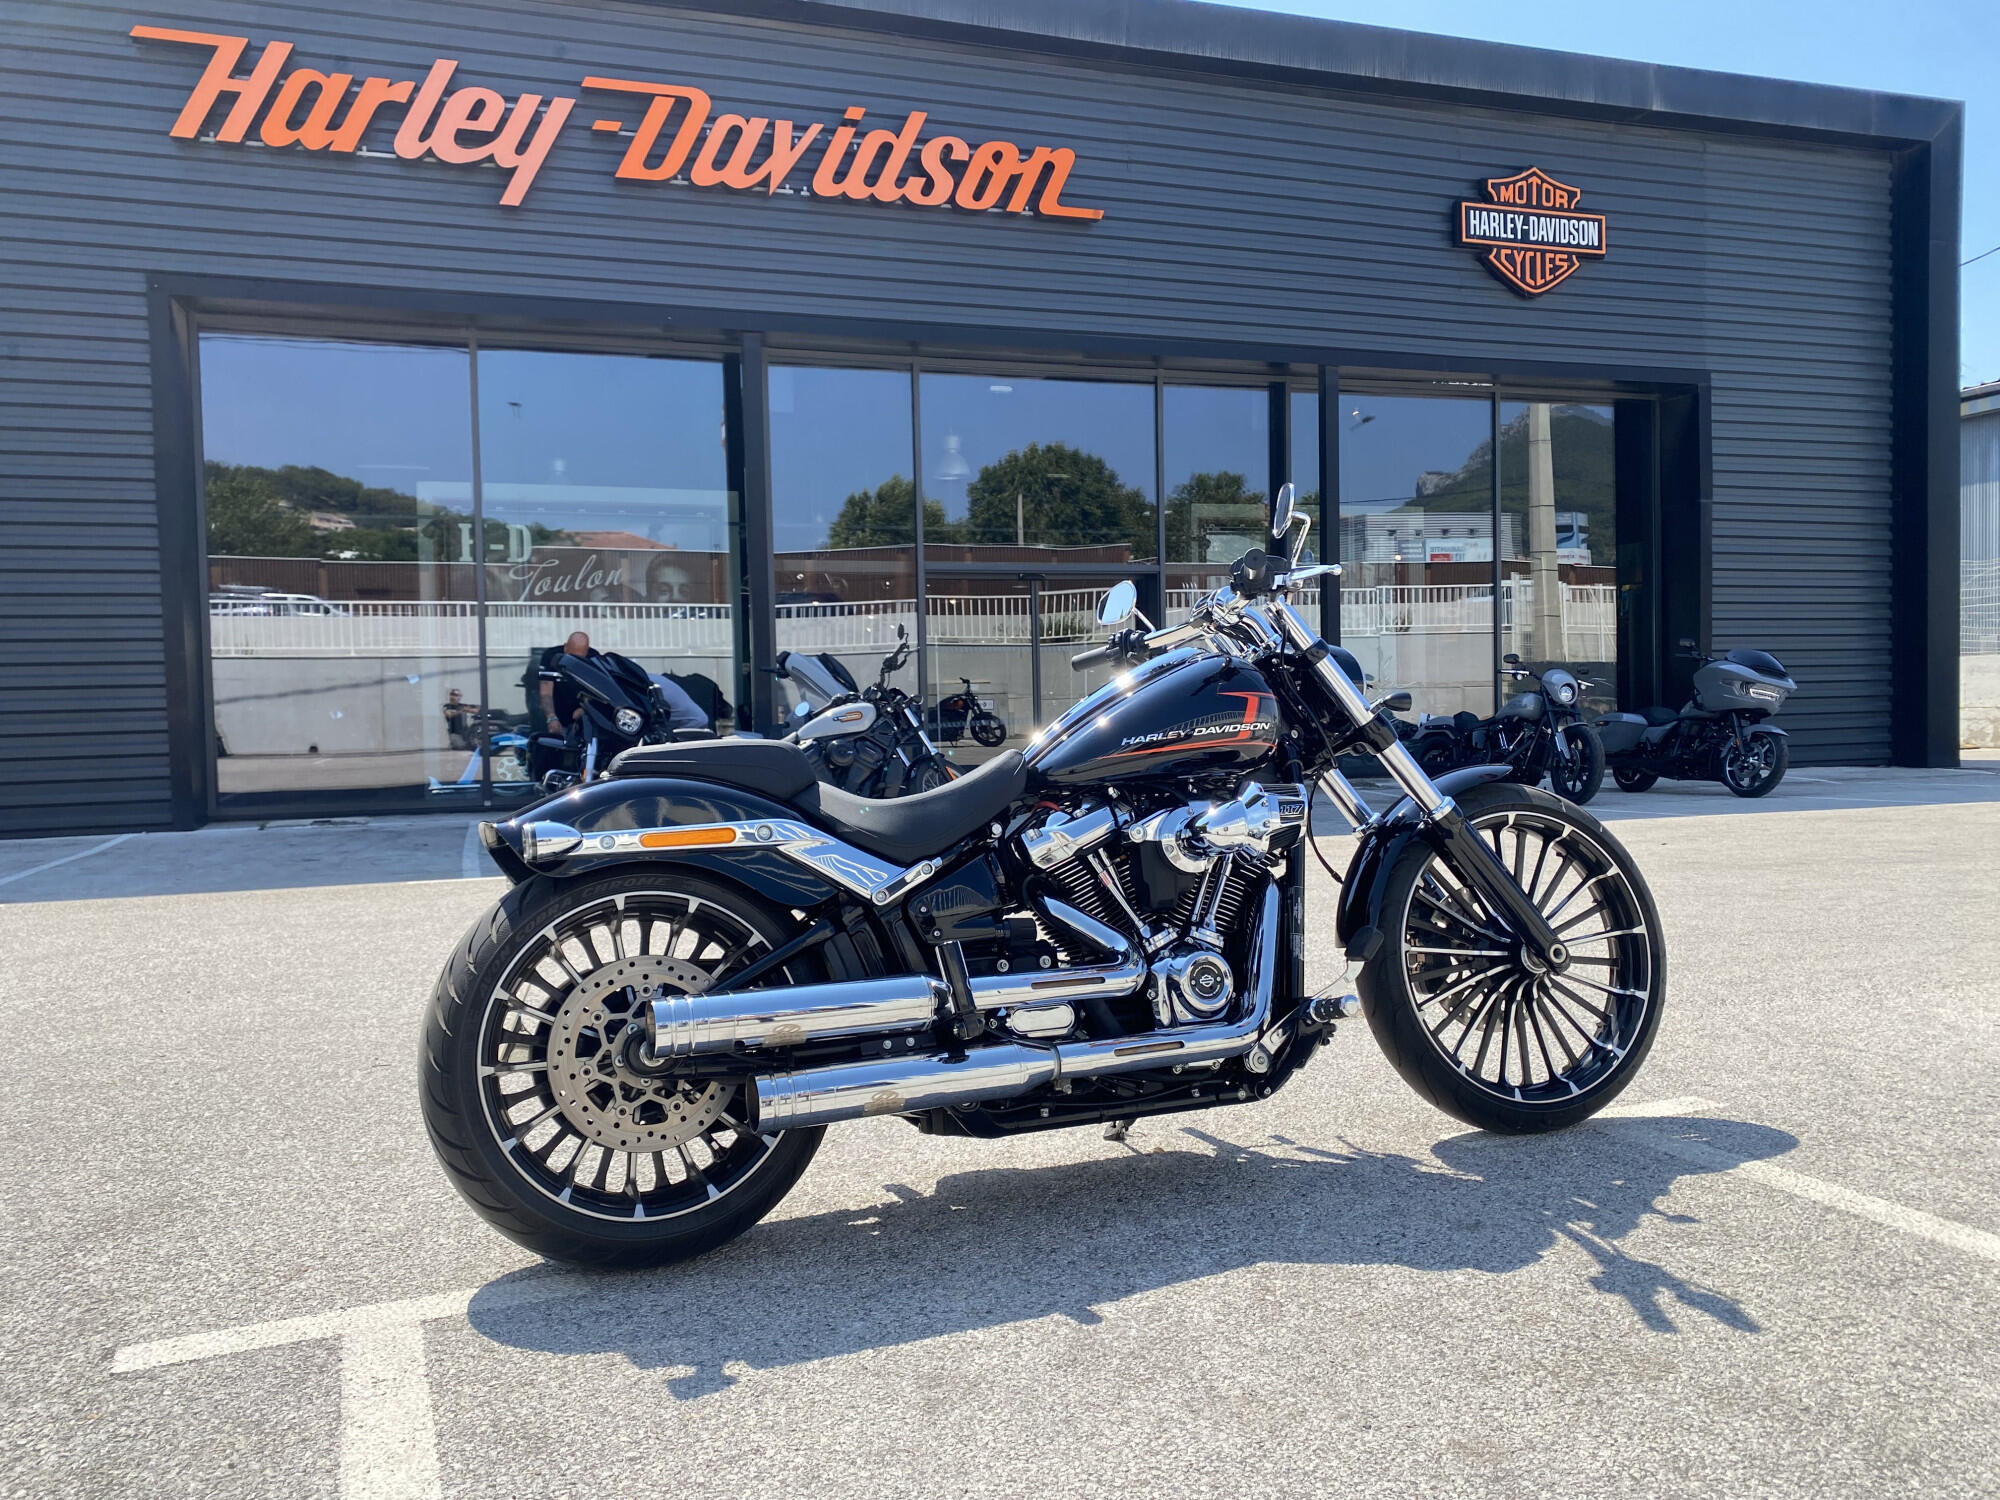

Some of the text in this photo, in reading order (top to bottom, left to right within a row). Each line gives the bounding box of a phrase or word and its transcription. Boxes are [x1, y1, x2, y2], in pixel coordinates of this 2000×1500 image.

[1499, 176, 1568, 208] MOTOR
[1469, 209, 1598, 246] HARLEY-DAVIDSON
[1500, 249, 1568, 286] CYCLES
[509, 554, 623, 601] Toulon
[1121, 722, 1271, 746] HARLEY-DAVIDSON
[1279, 803, 1304, 815] 117
